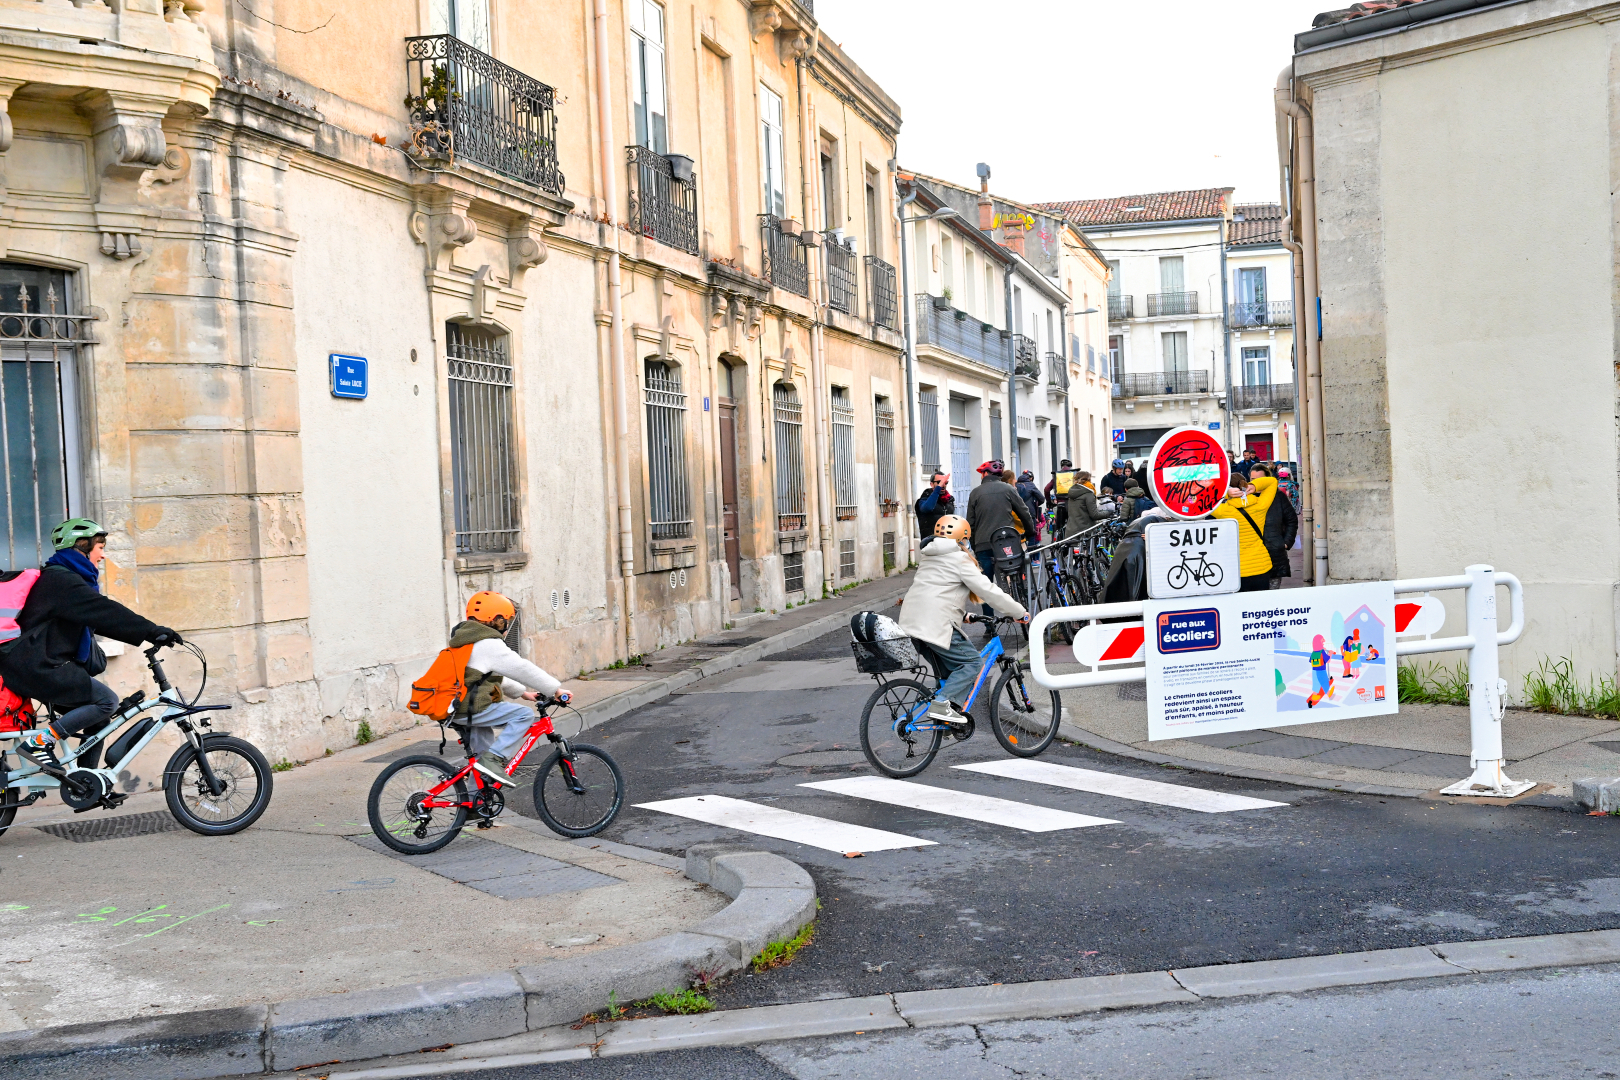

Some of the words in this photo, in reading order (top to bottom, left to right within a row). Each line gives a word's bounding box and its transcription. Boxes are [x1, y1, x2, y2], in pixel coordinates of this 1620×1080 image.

[1169, 527, 1218, 547] SAUF
[1242, 608, 1285, 620] Engagés
[1287, 606, 1311, 617] pour
[1172, 621, 1187, 629] rue
[1242, 618, 1287, 631] protéger
[1290, 618, 1308, 626] nos
[1163, 630, 1215, 643] écoliers
[1243, 630, 1286, 641] enfants.
[1226, 707, 1246, 715] pollué.
